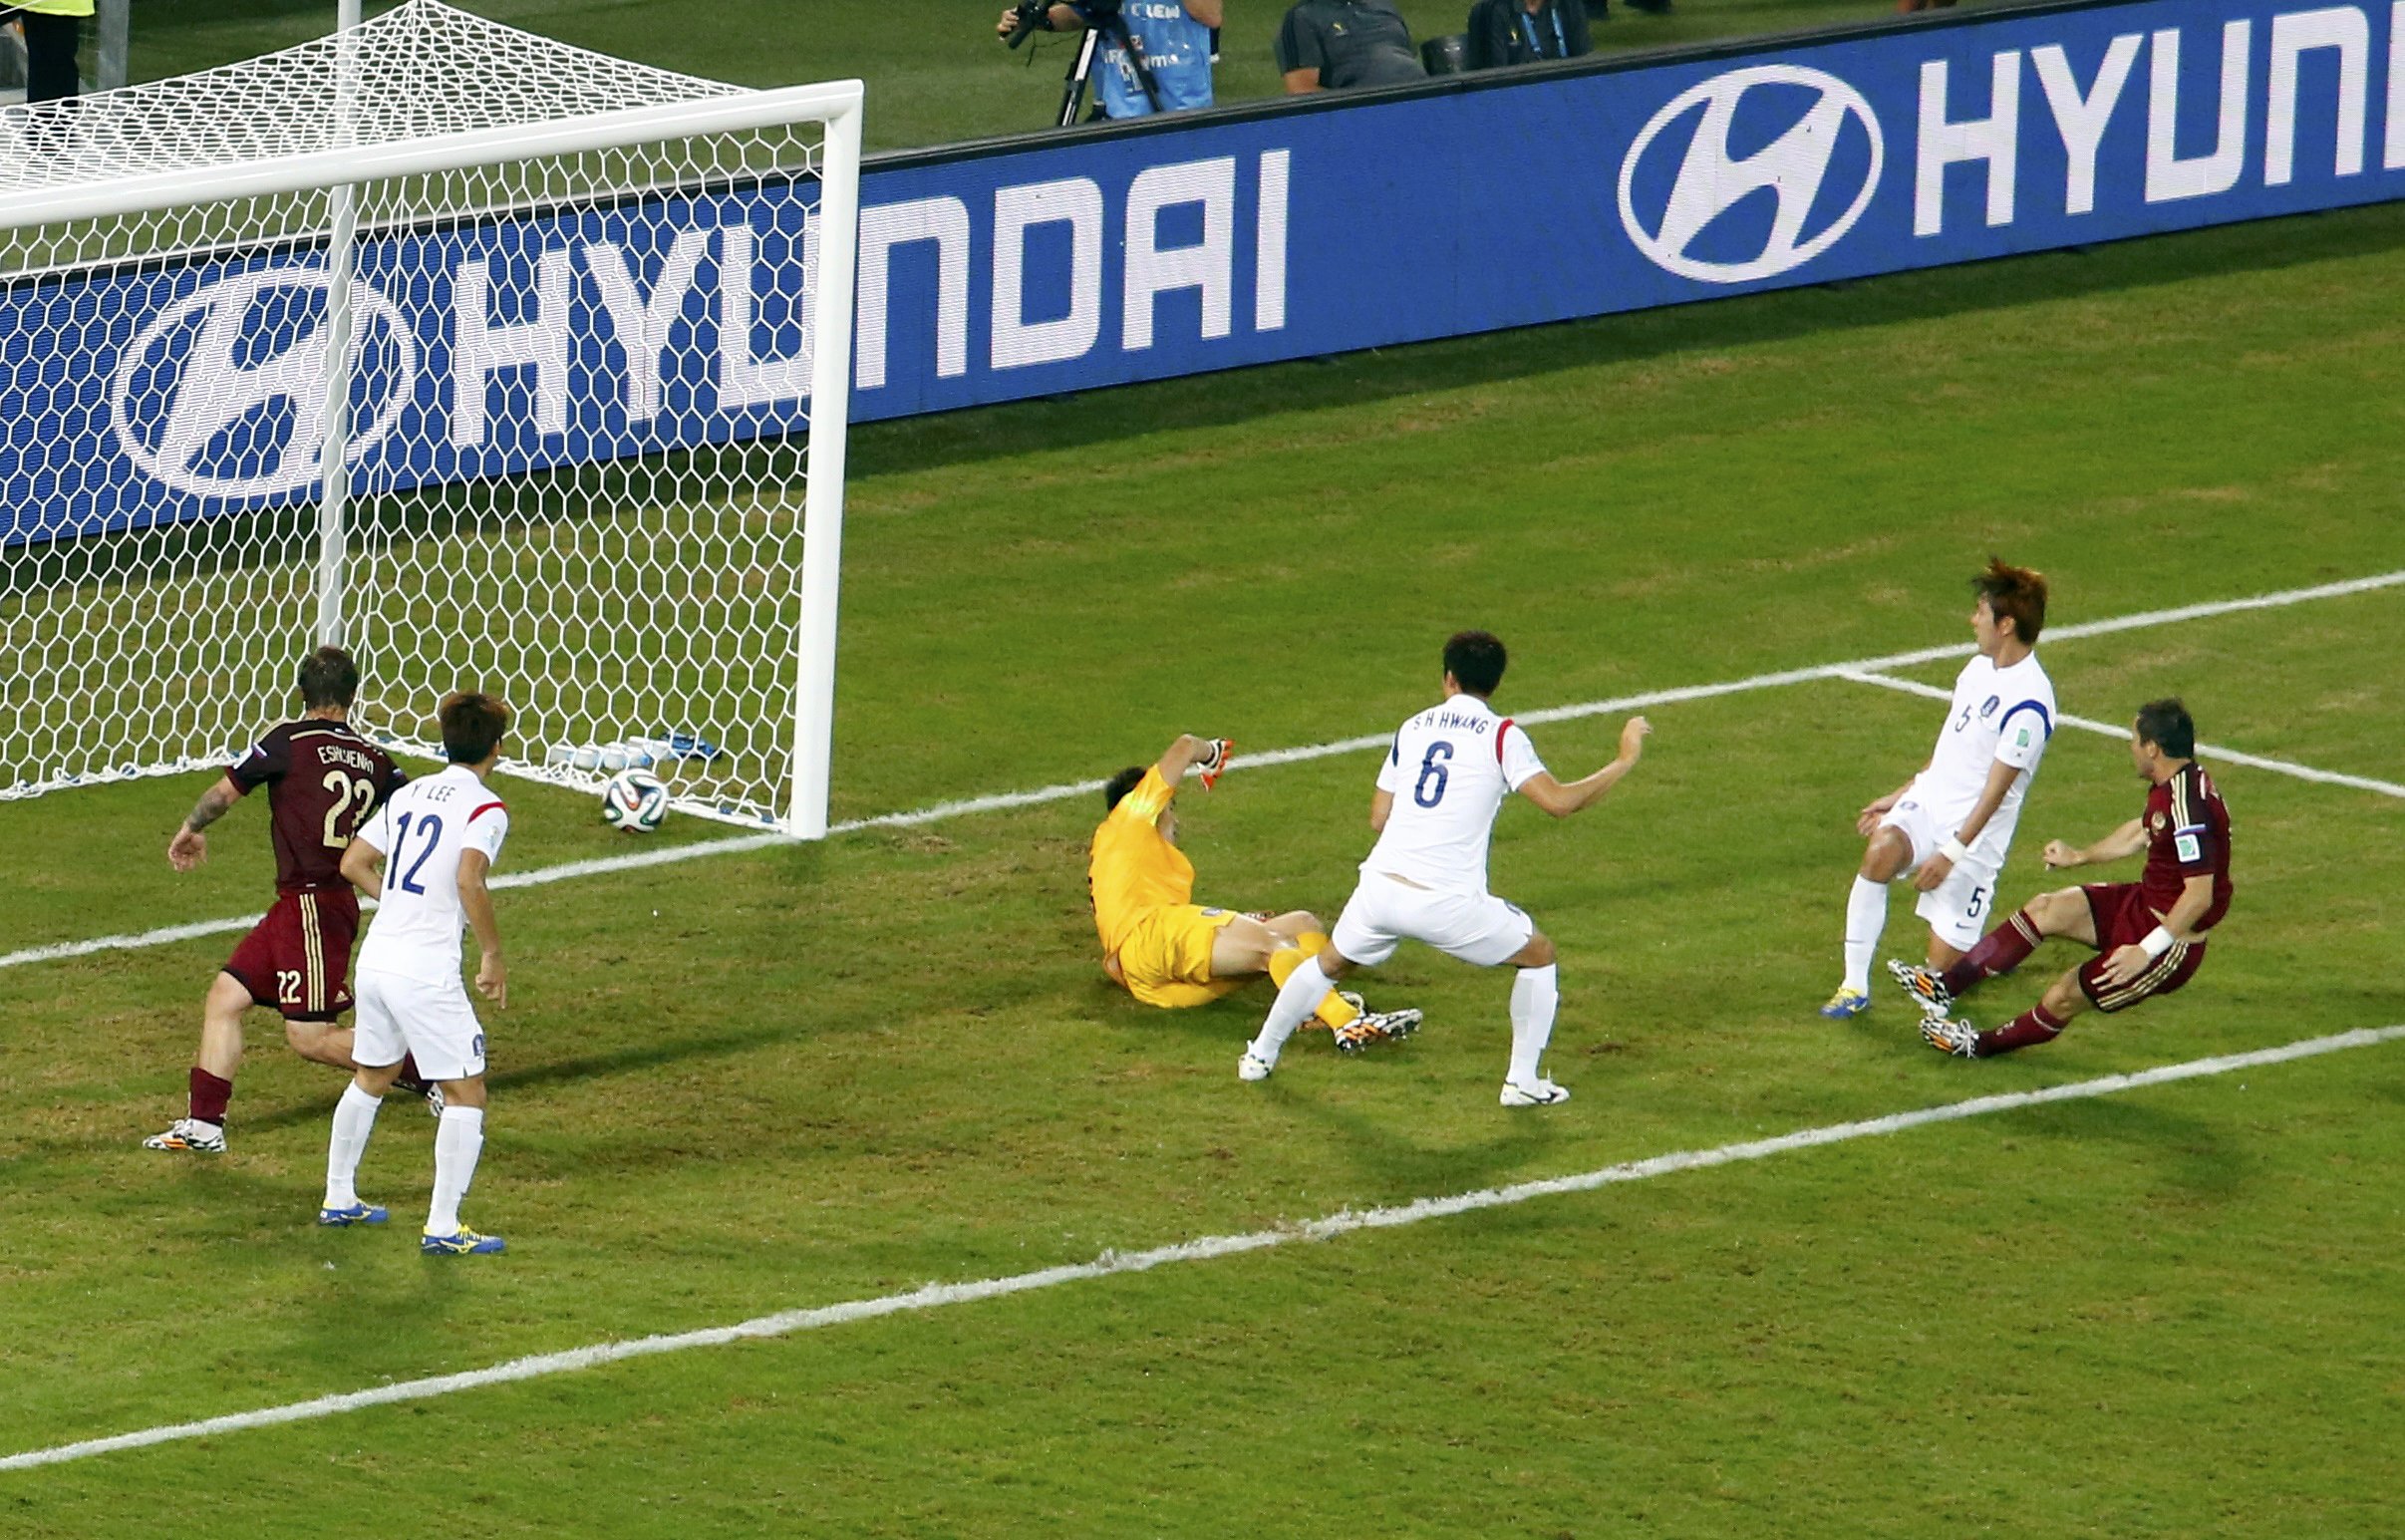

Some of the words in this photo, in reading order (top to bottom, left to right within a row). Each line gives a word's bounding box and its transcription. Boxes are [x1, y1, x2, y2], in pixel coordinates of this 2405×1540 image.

[1914, 6, 2405, 238] HYUN
[452, 150, 1290, 448] HYUNDAI
[1439, 713, 1489, 735] HWANG
[1954, 704, 1972, 733] 5
[427, 785, 455, 802] LEE
[1413, 741, 1454, 808] 6
[322, 770, 376, 849] 22
[387, 810, 444, 895] 12
[1966, 886, 1986, 918] 5
